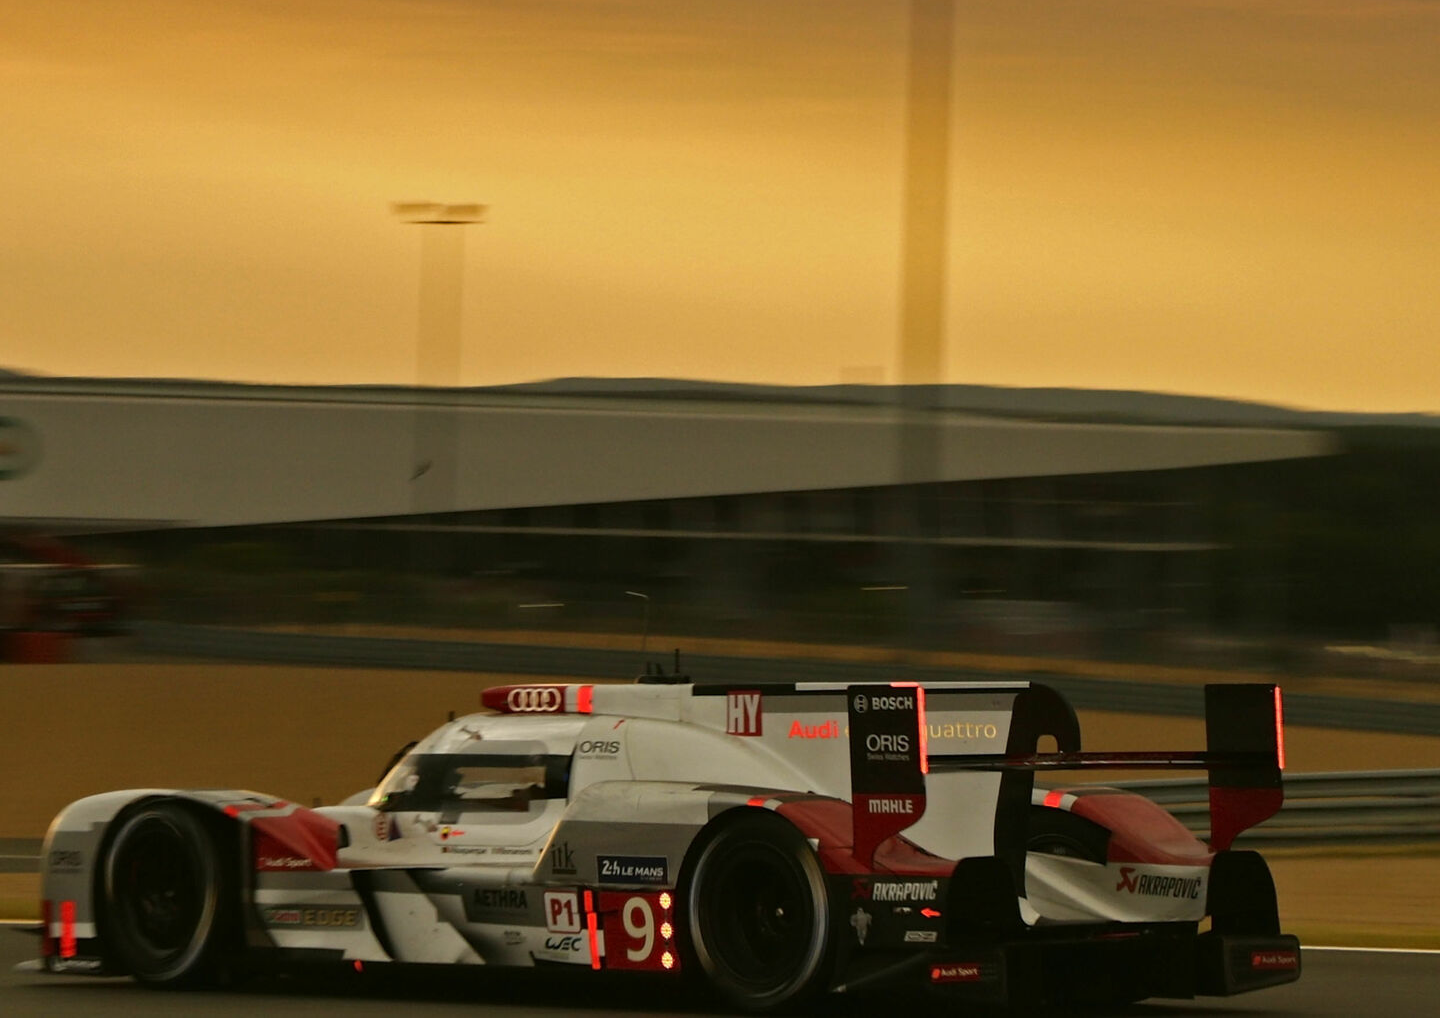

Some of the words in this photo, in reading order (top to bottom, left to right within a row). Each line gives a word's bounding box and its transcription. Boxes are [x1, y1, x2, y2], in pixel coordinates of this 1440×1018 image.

[872, 696, 913, 710] BOSCH
[728, 694, 760, 734] HY
[788, 719, 839, 739] Audi
[926, 723, 997, 739] uattro
[579, 740, 620, 754] ORIS
[866, 734, 910, 752] ORIS
[868, 799, 913, 814] MAHLE
[621, 866, 634, 877] LE
[635, 866, 664, 878] MANS
[473, 888, 528, 910] AETHRA
[303, 909, 358, 927] EDGE
[550, 898, 574, 926] P1
[622, 896, 655, 962] 9
[545, 936, 583, 952] WEC
